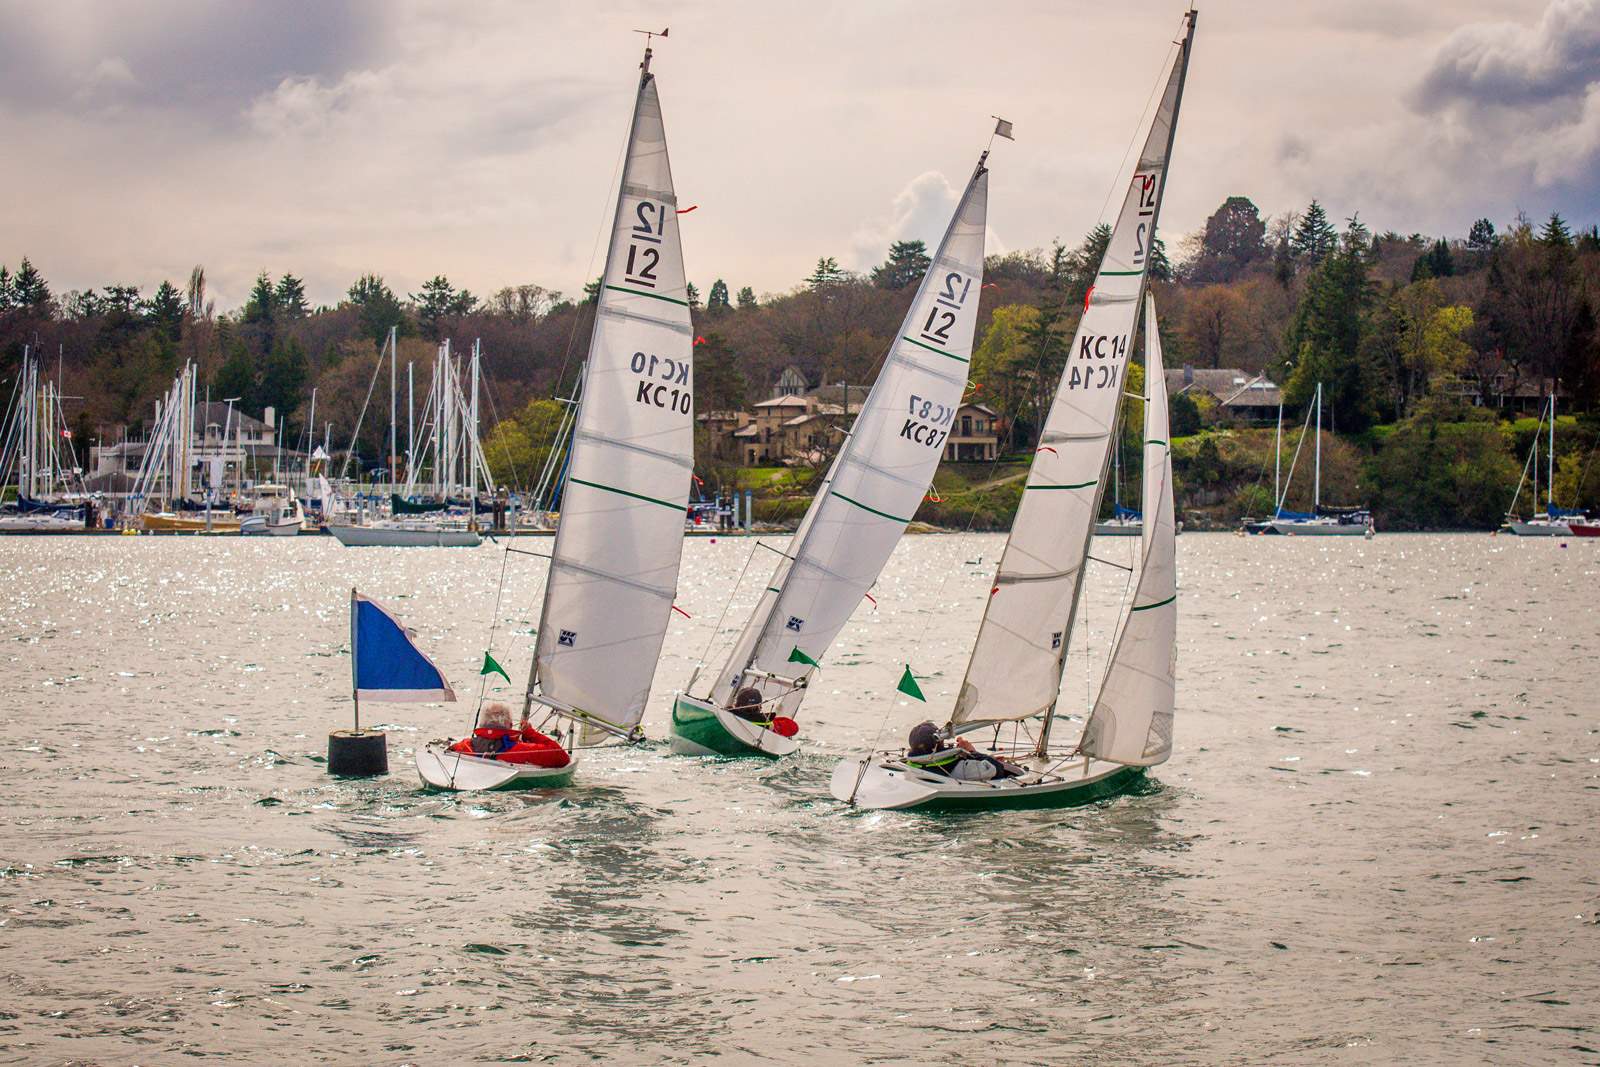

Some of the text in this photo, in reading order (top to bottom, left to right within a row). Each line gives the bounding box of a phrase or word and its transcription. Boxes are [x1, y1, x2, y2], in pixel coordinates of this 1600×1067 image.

[1140, 173, 1156, 208] 12
[626, 244, 660, 281] 12
[923, 306, 956, 340] 12
[1079, 334, 1127, 359] KC14
[636, 380, 691, 415] KC10
[900, 418, 947, 449] KC87
